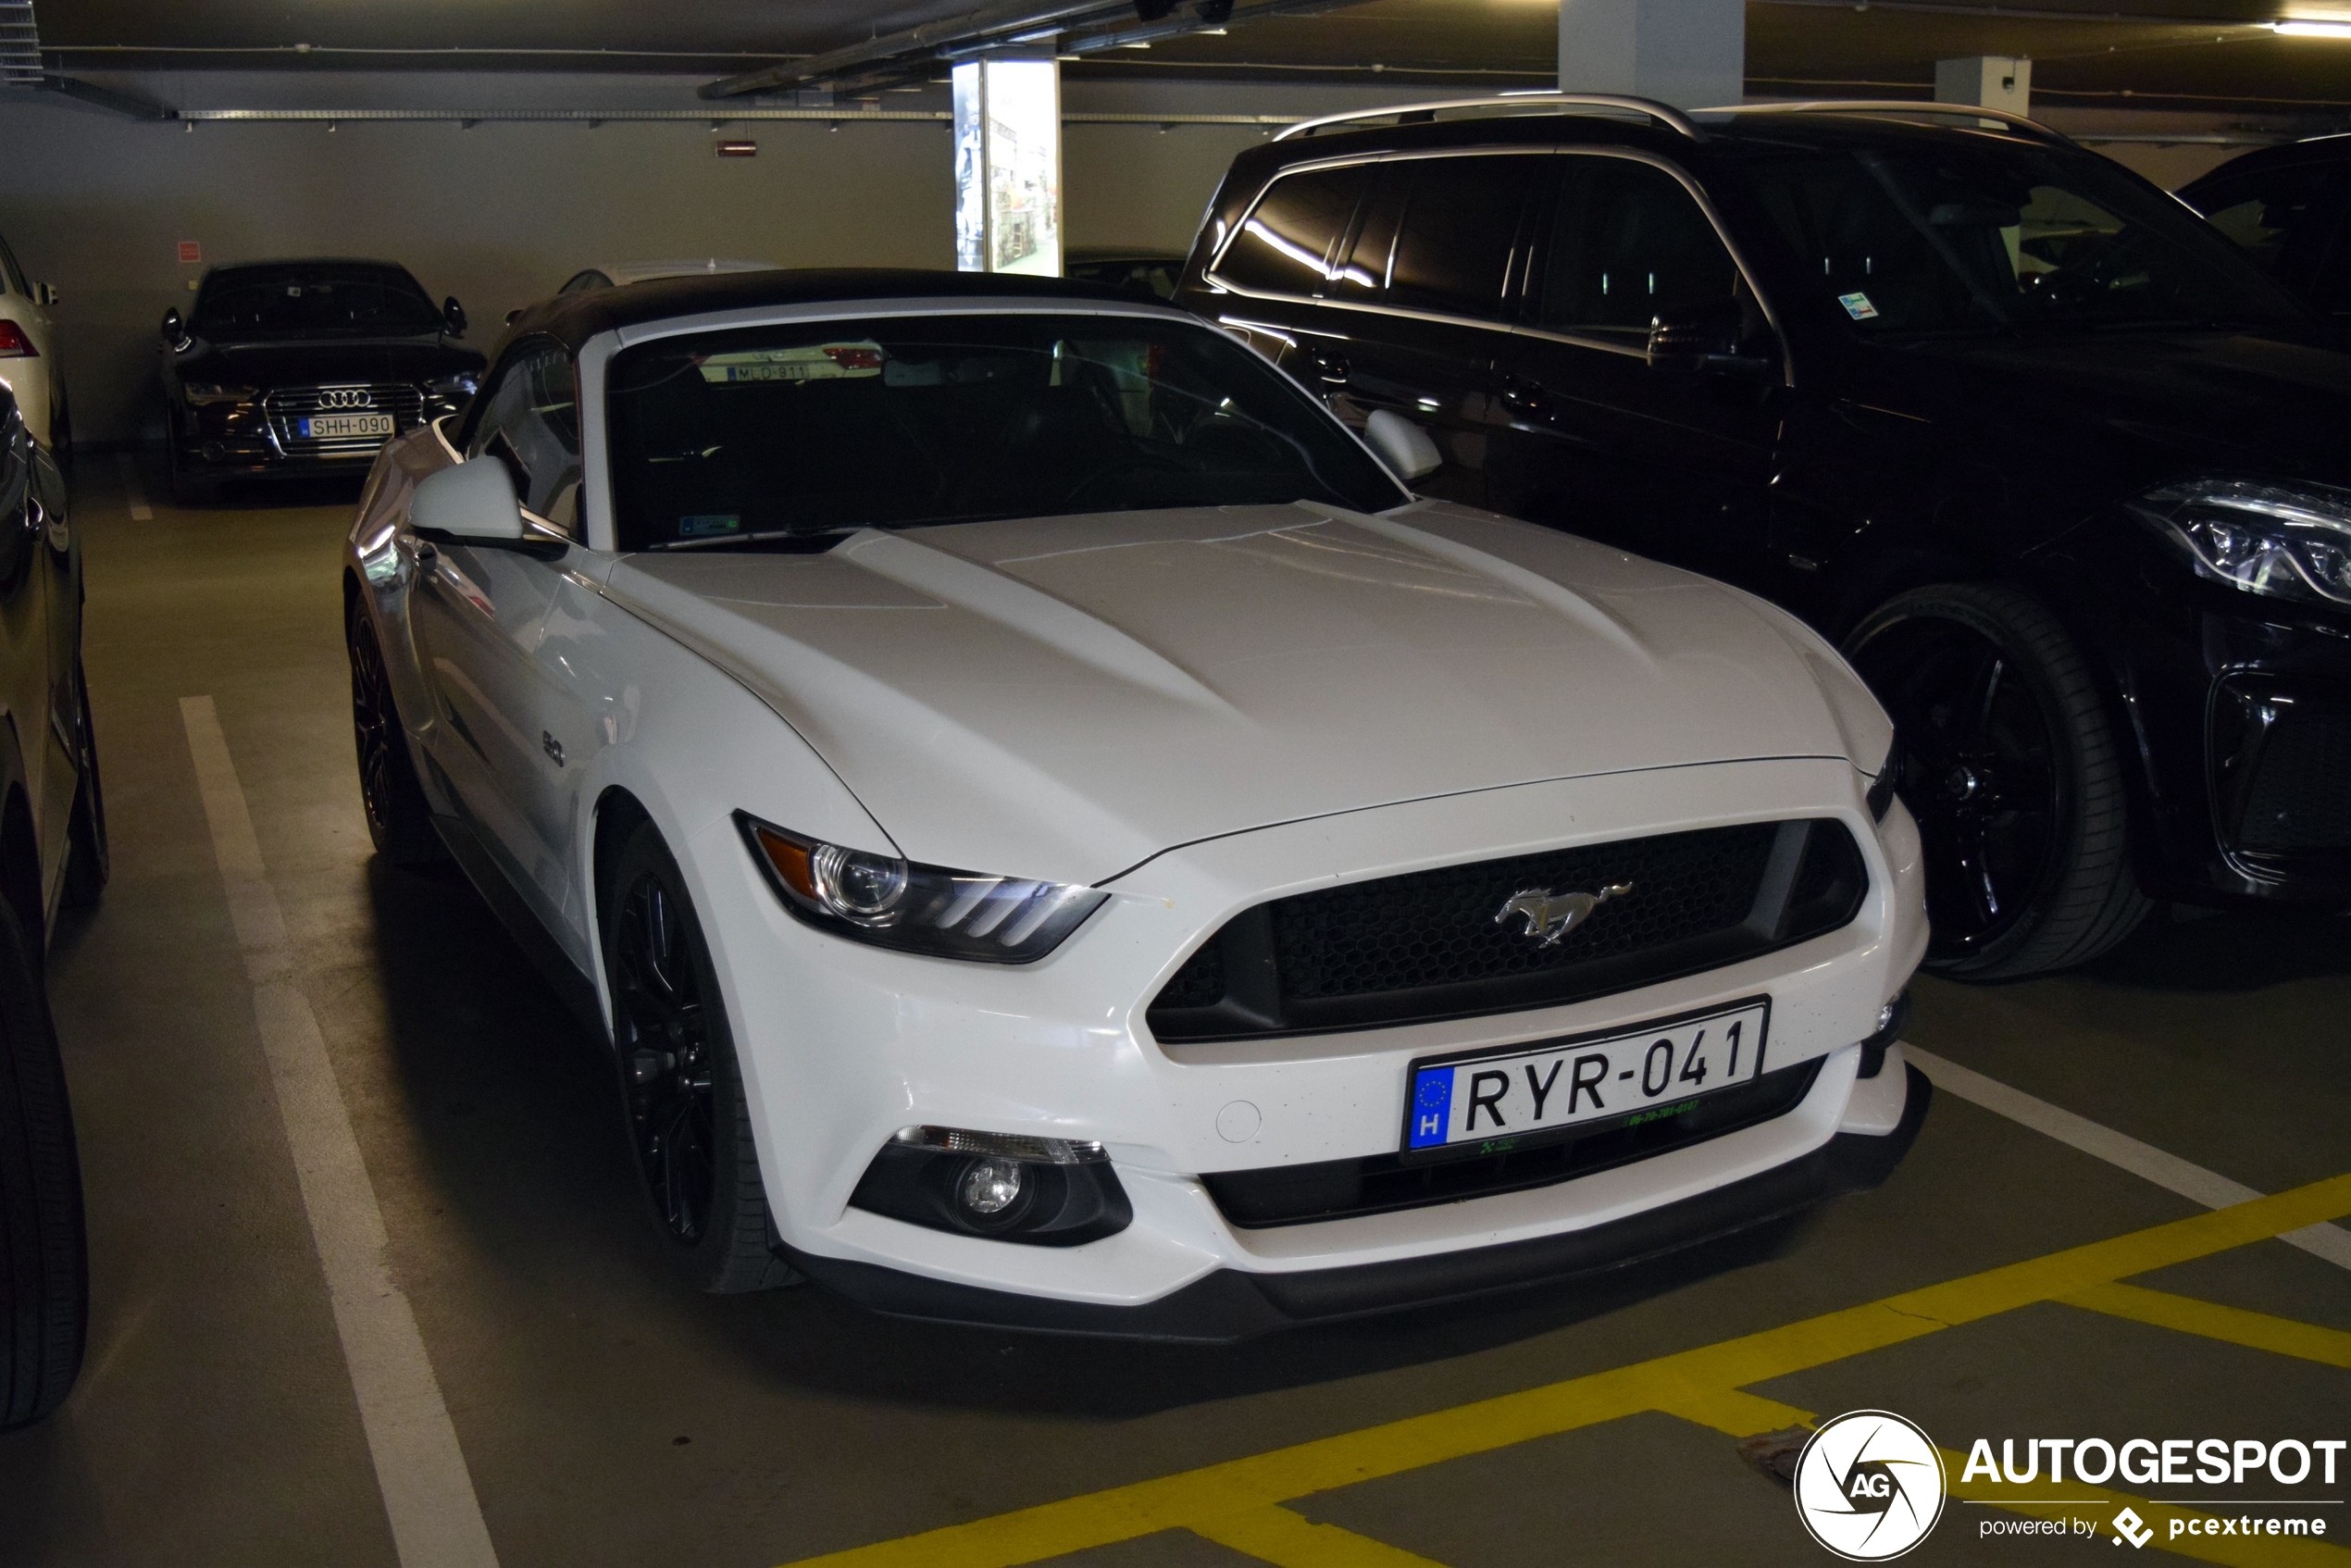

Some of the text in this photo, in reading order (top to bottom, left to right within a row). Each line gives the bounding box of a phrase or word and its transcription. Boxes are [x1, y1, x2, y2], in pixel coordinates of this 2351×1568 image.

[739, 367, 804, 380] MLD-911
[314, 417, 390, 435] SHH-090
[1465, 1020, 1742, 1131] RYR-041
[1420, 1114, 1438, 1136] H
